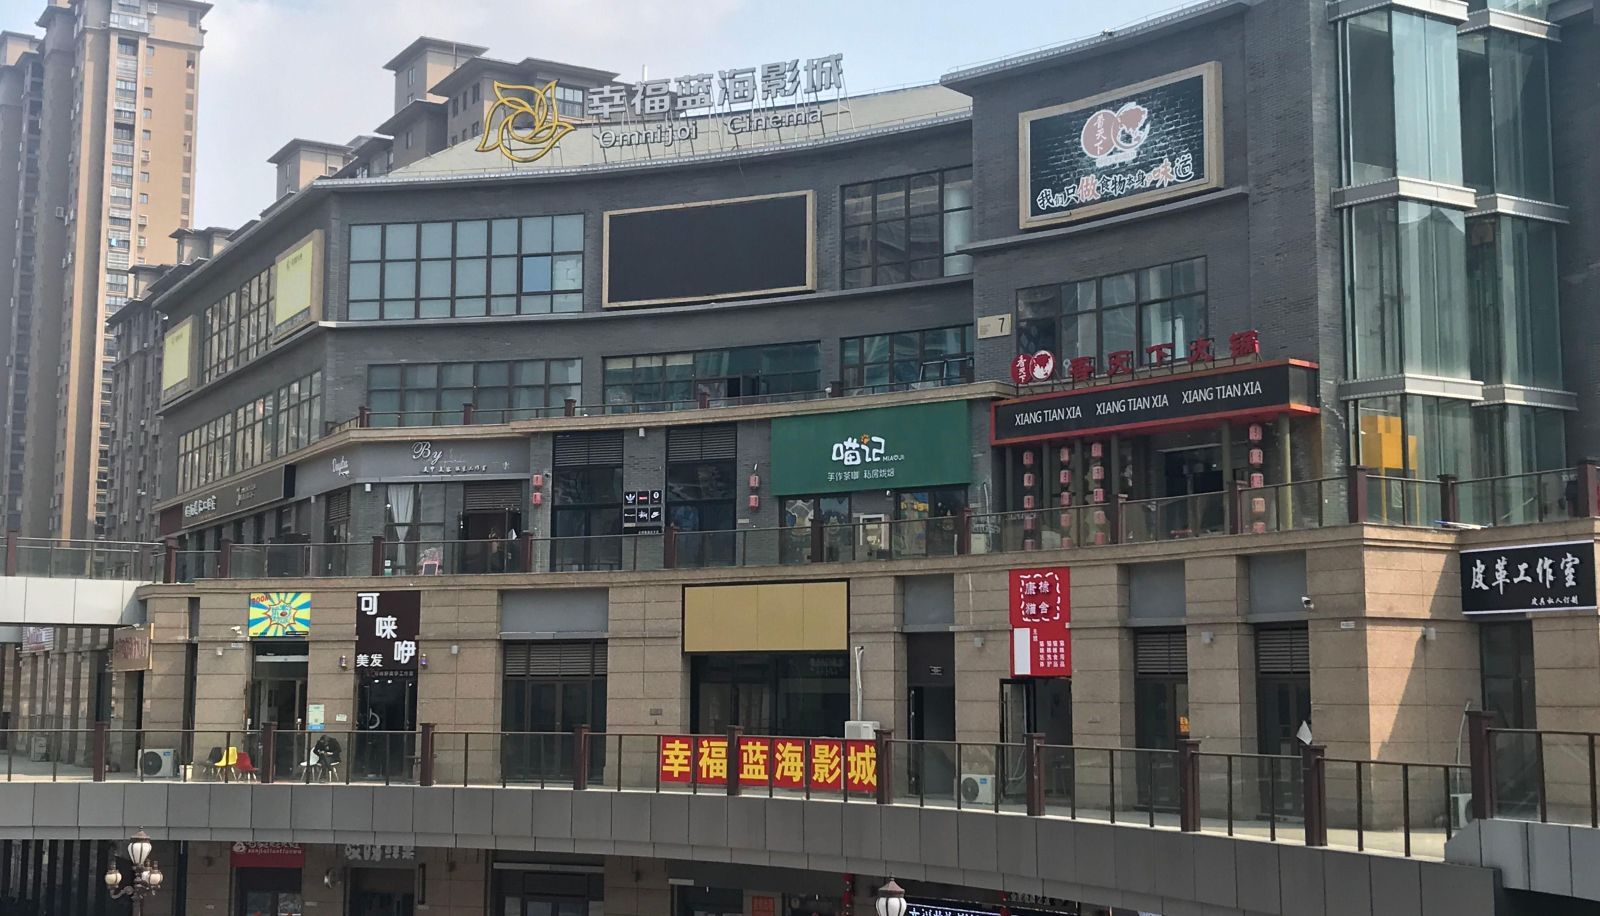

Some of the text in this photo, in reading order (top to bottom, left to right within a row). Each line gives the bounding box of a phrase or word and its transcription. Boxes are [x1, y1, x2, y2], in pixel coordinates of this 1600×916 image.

[588, 53, 843, 119] 幸福蓝海影城
[599, 109, 823, 148] Omnijoi Cinema
[998, 317, 1005, 333] 7
[1015, 381, 1262, 426] XIANG TIAN XIA XIANG TIAN XIA XIANG TIAN XIA
[411, 441, 442, 466] By
[832, 436, 885, 466] 喵记
[882, 454, 904, 462] MIAOJI
[1470, 552, 1580, 595] 皮革工作室
[356, 653, 383, 667] 美发
[662, 739, 877, 785] 幸福蓝海影城
